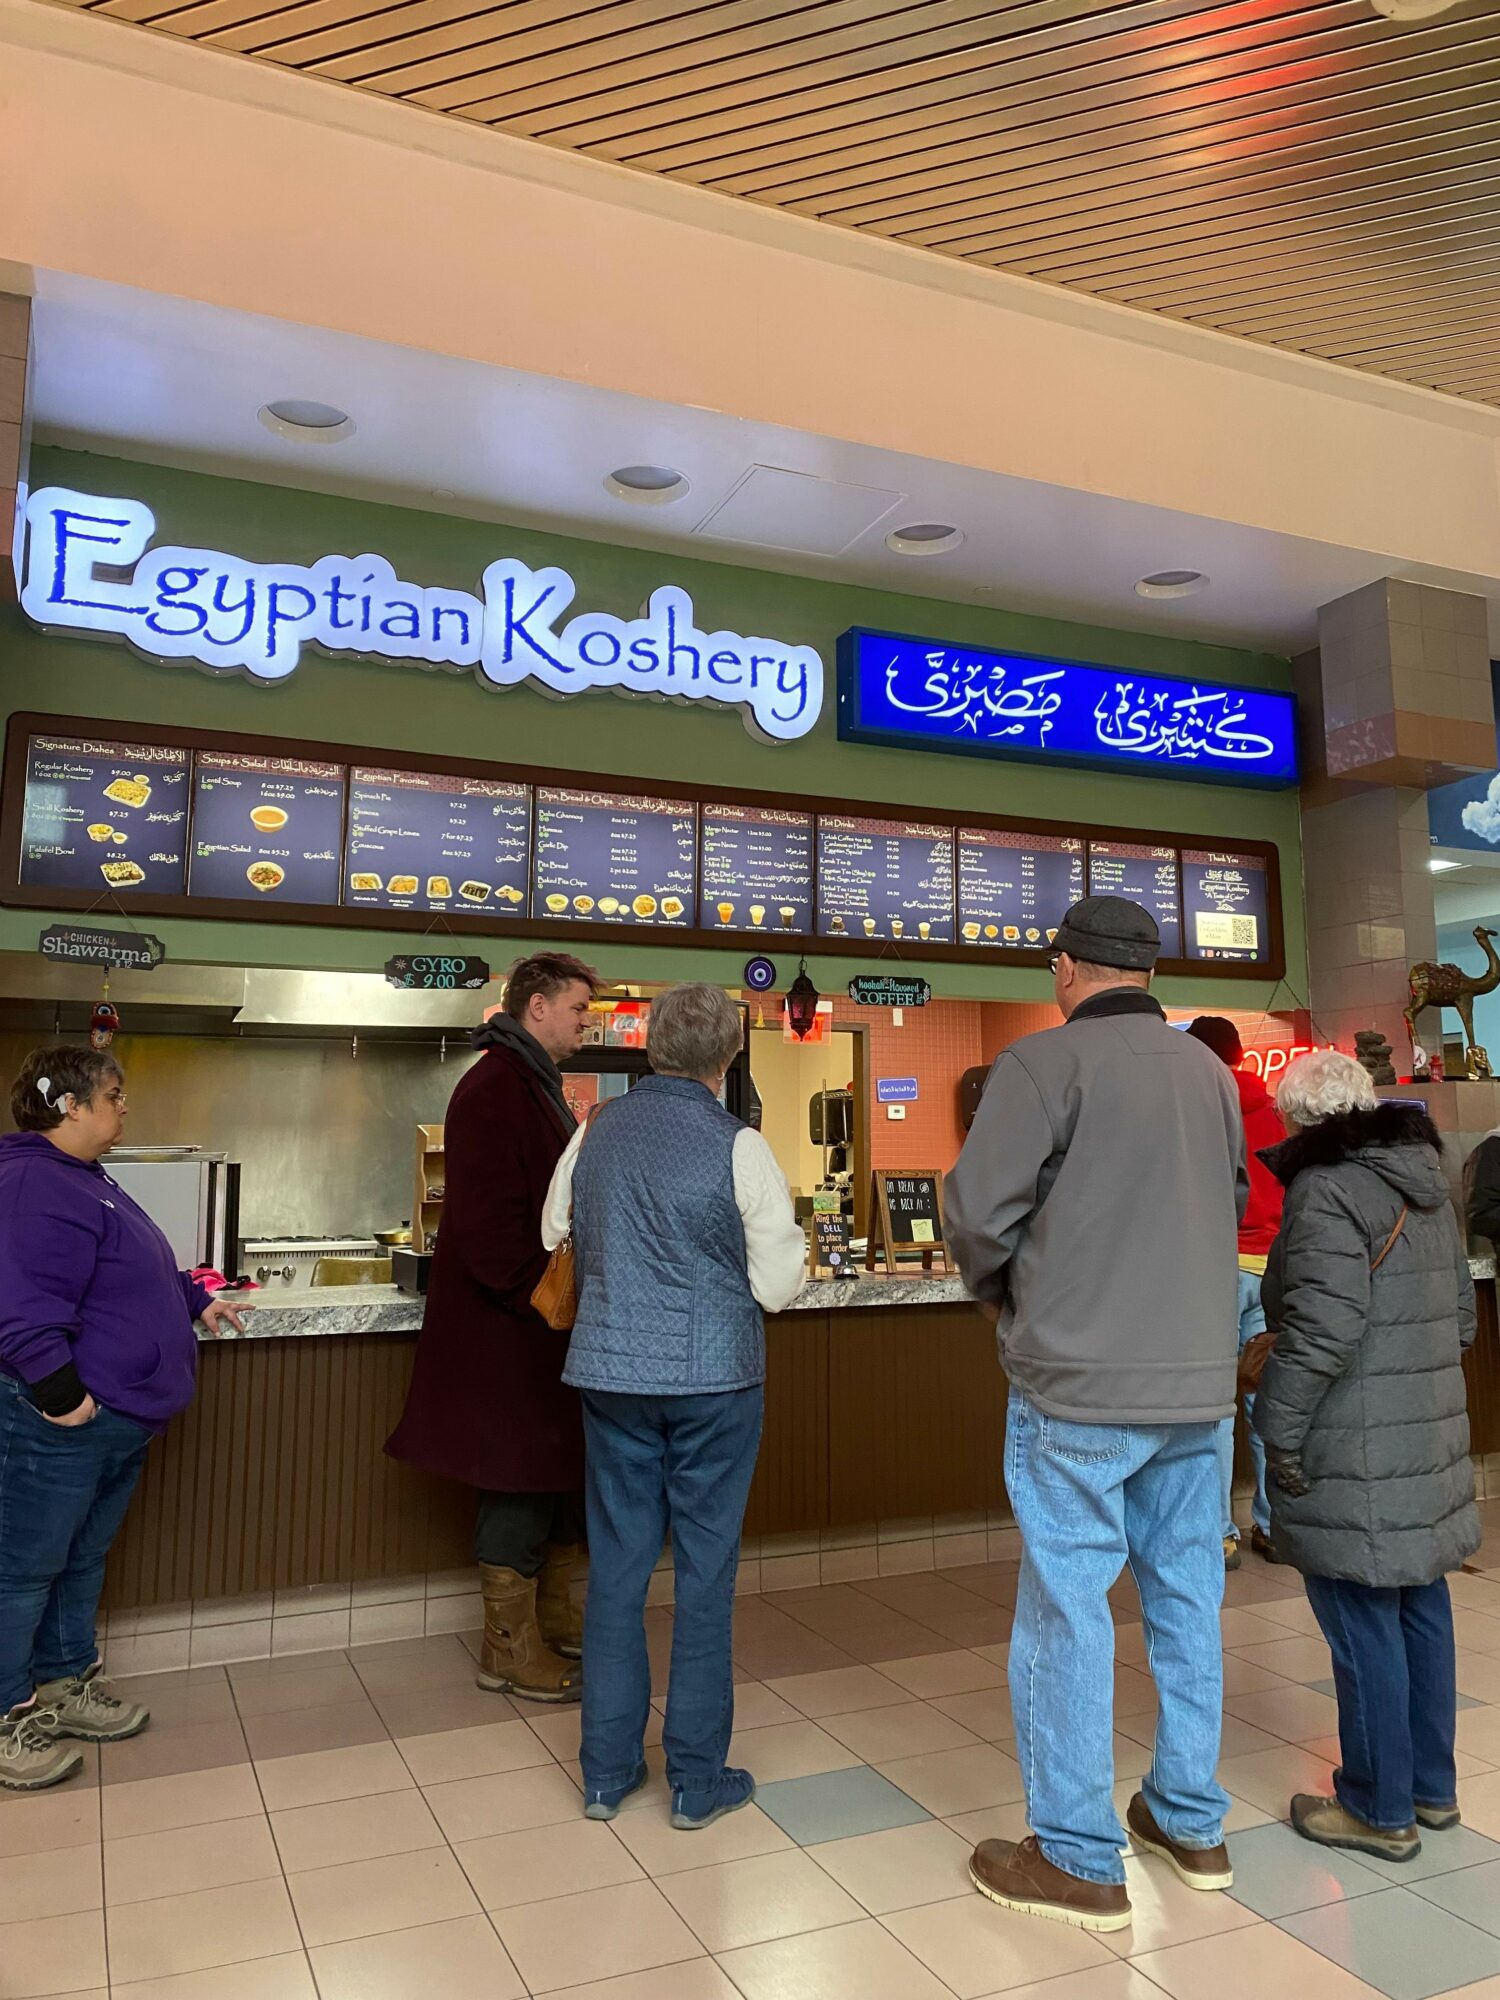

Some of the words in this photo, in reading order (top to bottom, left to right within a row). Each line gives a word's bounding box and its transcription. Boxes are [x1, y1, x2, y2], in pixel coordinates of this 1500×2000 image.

[47, 509, 469, 658] Egyptian
[502, 576, 807, 722] Koshery
[35, 739, 80, 751] Signature
[83, 743, 115, 755] Dishes
[201, 754, 231, 766] Soups
[240, 758, 267, 768] Salad
[34, 761, 62, 770] Regular
[63, 763, 94, 775] Koshery
[202, 776, 222, 784] Lentil
[222, 778, 242, 788] Soup
[354, 770, 392, 783] Egyptian
[393, 774, 430, 786] Favorites
[353, 790, 380, 801] Spinach
[381, 793, 392, 801] Pie
[539, 790, 559, 802] Dips,
[560, 792, 584, 802] Bread
[591, 795, 614, 807] Chips
[54, 806, 84, 816] Koshery
[538, 810, 556, 818] Baba
[704, 806, 722, 814] Cold
[722, 808, 744, 817] Drinks
[820, 818, 834, 827] Hot
[834, 820, 855, 828] Drinks
[353, 824, 378, 834] Stuffed
[378, 826, 398, 837] Grape
[398, 828, 420, 837] Leaves
[960, 832, 986, 841] Desserts
[28, 844, 54, 854] Falafel
[55, 846, 76, 855] Bowl
[198, 842, 230, 852] Egyptian
[230, 844, 252, 853] Salad
[352, 840, 384, 850] Couscous
[538, 840, 556, 850] Garlic
[556, 842, 568, 852] Dip
[1090, 844, 1109, 852] Extras
[1208, 854, 1226, 862] Thank
[1226, 856, 1238, 864] You
[538, 860, 549, 869] Pita
[550, 861, 568, 870] Bread
[538, 876, 557, 885] Baked
[558, 877, 570, 886] Pita
[570, 878, 588, 888] Chips
[1200, 880, 1226, 893] Egyptian
[1226, 883, 1250, 894] Koshery
[70, 932, 110, 946] CHICKEN
[42, 936, 152, 964] Shawarma
[124, 960, 133, 969] 12
[412, 957, 466, 974] GYRO
[404, 972, 416, 986] $
[424, 974, 456, 988] 9.00
[857, 992, 915, 1006] COFFEE
[816, 1215, 830, 1224] Ring
[832, 1215, 843, 1223] the
[823, 1224, 843, 1233] BELL
[818, 1234, 826, 1242] to
[826, 1234, 842, 1244] place
[822, 1244, 830, 1252] an
[832, 1244, 848, 1253] order
